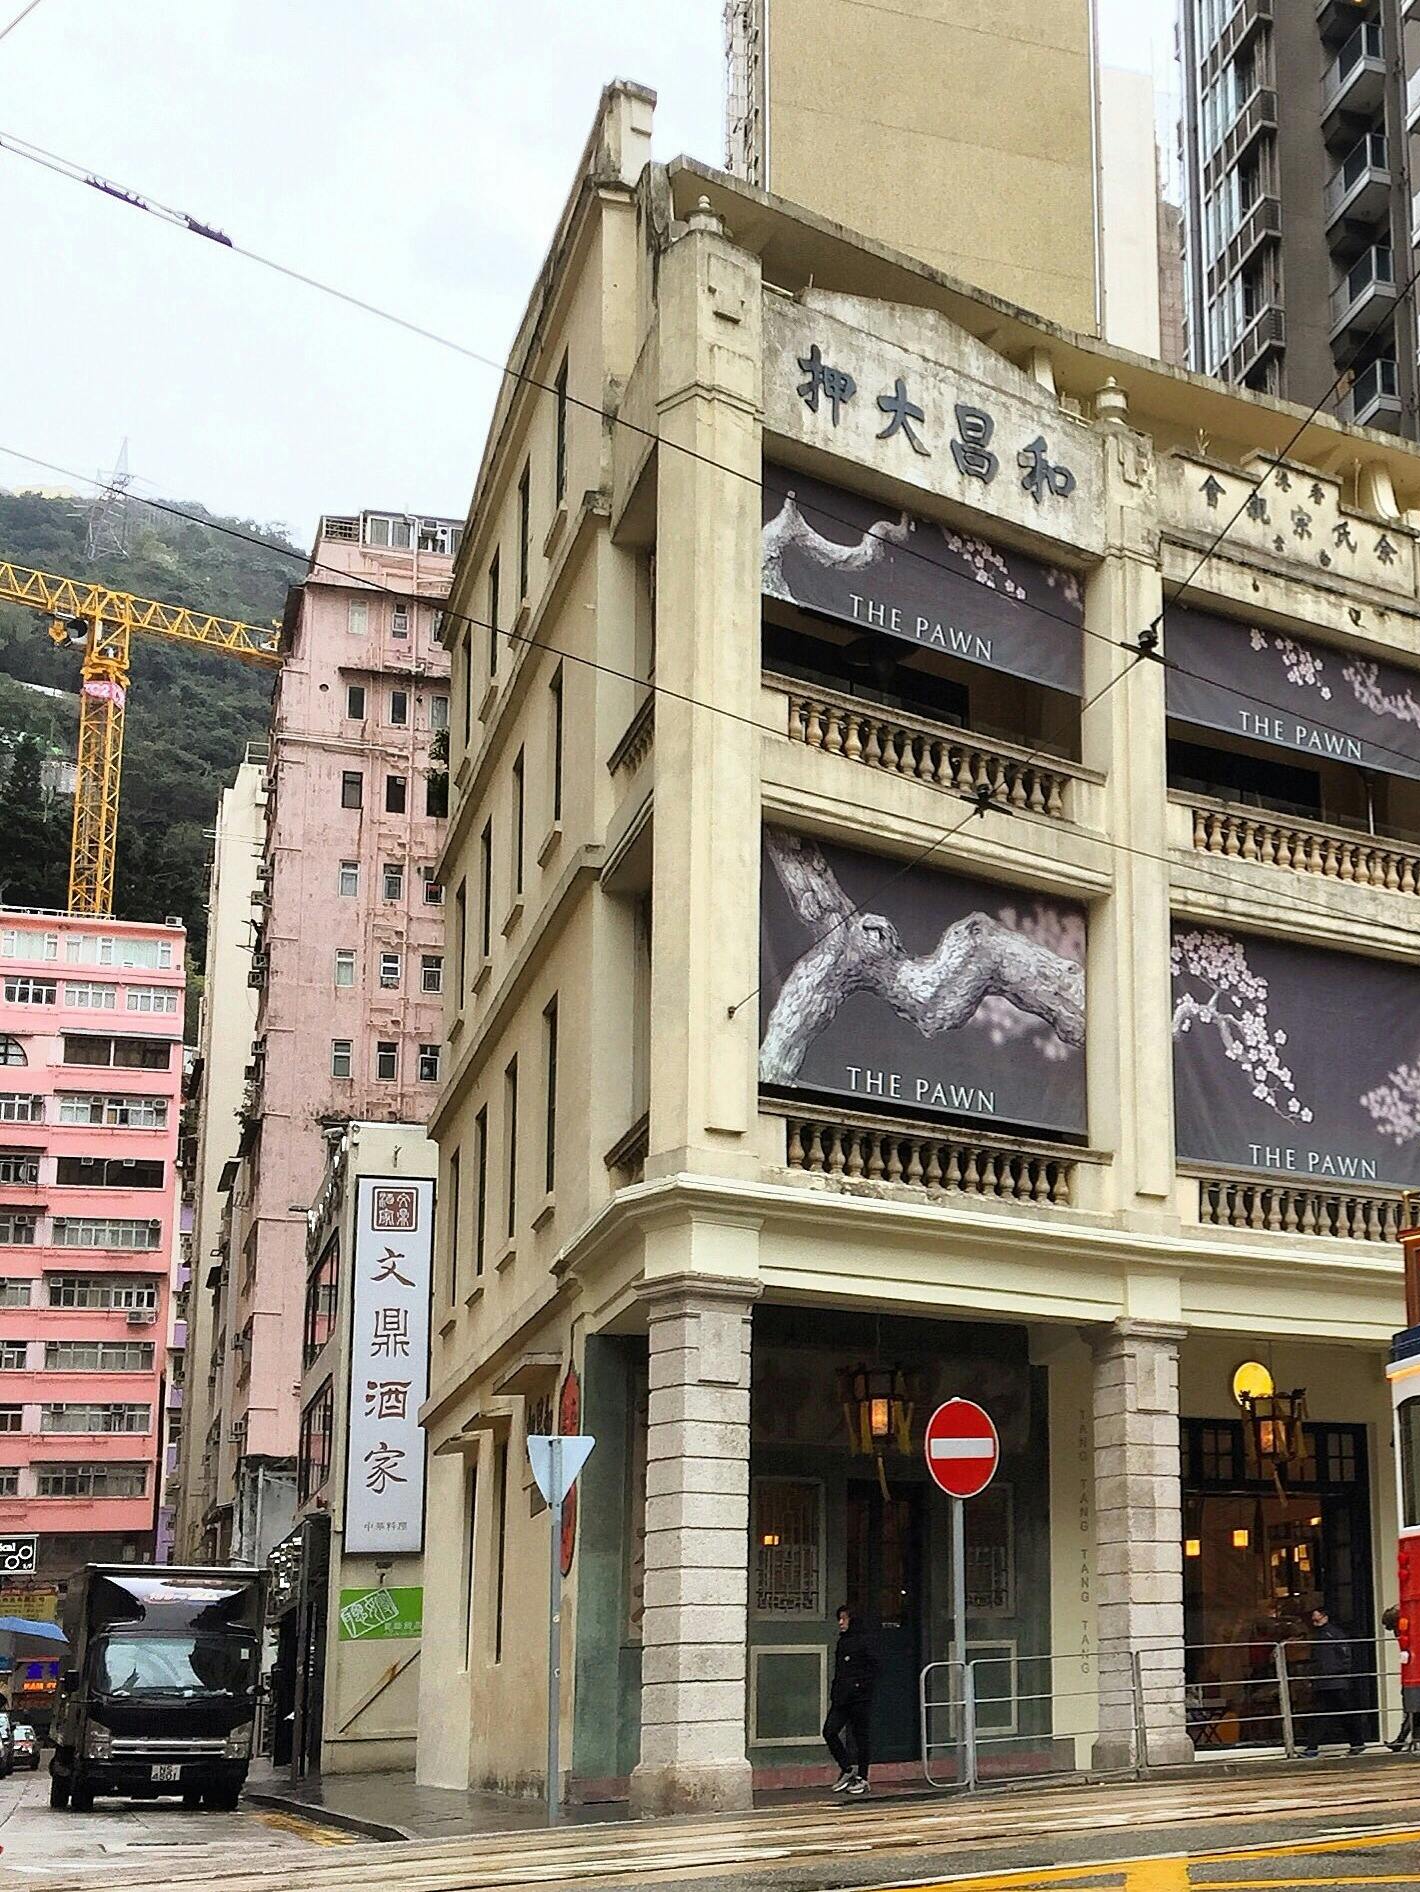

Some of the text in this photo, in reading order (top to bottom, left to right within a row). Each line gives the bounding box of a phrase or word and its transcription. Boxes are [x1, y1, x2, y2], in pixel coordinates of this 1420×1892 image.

[849, 593, 993, 661] THE PAWN
[1238, 710, 1362, 760] THE PAWN
[846, 1066, 996, 1113] THE PAWN
[1248, 1143, 1378, 1179] THE PAWN
[364, 1246, 416, 1495] 文鼎酒家
[1080, 1410, 1090, 1674] TANG TANG TANG TANG
